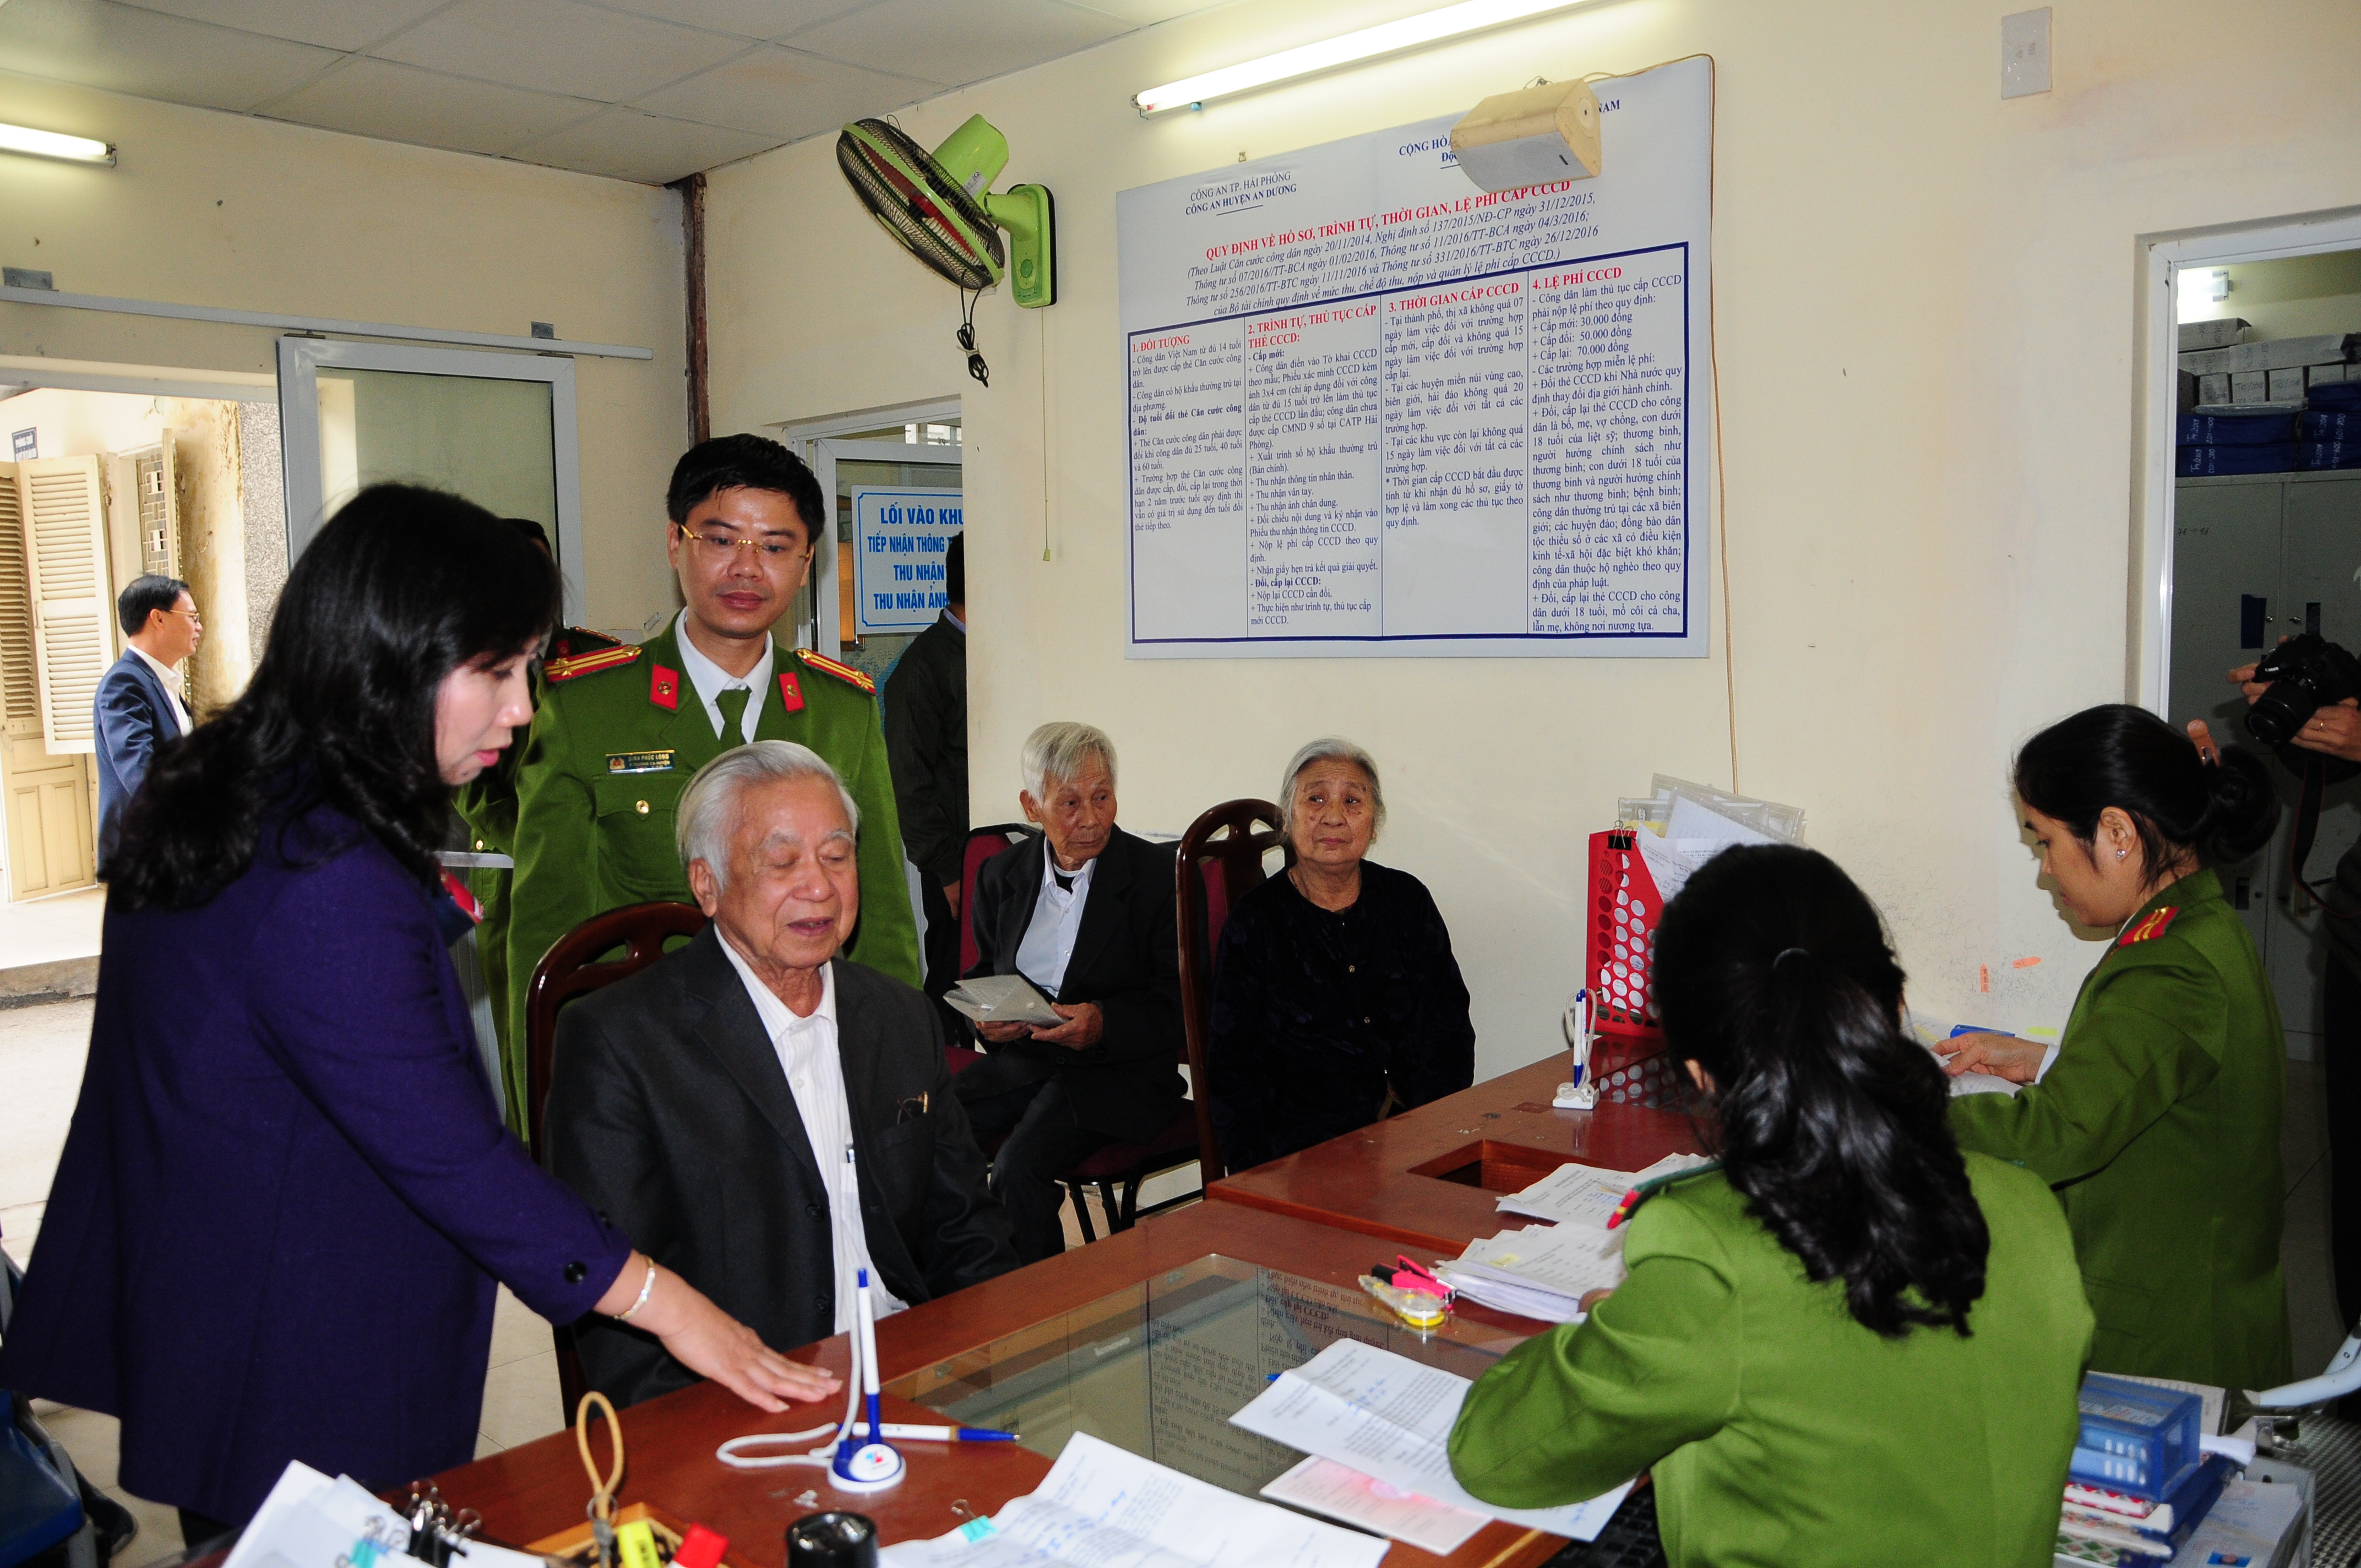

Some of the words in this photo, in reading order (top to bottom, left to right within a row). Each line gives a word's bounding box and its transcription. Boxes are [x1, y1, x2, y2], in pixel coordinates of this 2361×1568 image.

[1399, 141, 1429, 156] CỘNG
[1432, 134, 1451, 150] HÒ
[1185, 202, 1208, 215] CÔNG
[1209, 199, 1221, 210] AN
[1222, 192, 1250, 207] HUYỆN
[1252, 189, 1264, 201] AN
[1265, 183, 1297, 198] DƯƠNG
[1189, 187, 1214, 202] CÔNG
[1215, 184, 1227, 196] AN
[1228, 182, 1242, 193] TP.
[1243, 177, 1259, 190] HẢI
[1260, 171, 1291, 186] PHÒNG
[1205, 244, 1228, 262] QUY
[1231, 238, 1259, 256] ĐỊNH
[1260, 232, 1276, 248] VỀ
[1278, 229, 1297, 246] HỒ
[1297, 227, 1316, 242] SƠ,
[1317, 219, 1356, 238] TRÌNH
[1358, 214, 1379, 232] TỰ,
[1380, 206, 1413, 226] THỜI
[1415, 202, 1452, 219] GIAN,
[1454, 196, 1472, 214] LỆ
[1531, 278, 1541, 290] 4.
[1543, 274, 1560, 290] LỆ
[1562, 271, 1584, 286] PHÍ
[1586, 266, 1622, 282] CCCD
[1388, 301, 1397, 313] 3.
[1399, 294, 1427, 311] THỜI
[1429, 291, 1458, 306] GIAN
[1460, 286, 1484, 301] CẤP
[1486, 282, 1519, 297] CCCD
[1247, 324, 1255, 334] 2.
[1256, 317, 1287, 333] TRÌNH
[1289, 314, 1307, 329] TỰ,
[1308, 312, 1330, 325] THỦ
[1331, 308, 1353, 323] TỤC
[1354, 302, 1377, 318] CẤP
[1132, 343, 1139, 353] 1.
[1140, 337, 1156, 352] ĐỐI
[1157, 334, 1190, 349] TƯỢNG
[1247, 333, 1267, 349] THẺ
[1269, 332, 1300, 346] CCCD:
[880, 502, 902, 524] LỐI
[907, 504, 934, 524] VÀO
[867, 530, 886, 552] TIẾP
[889, 533, 914, 556] NHẬN
[916, 533, 945, 553] THÔNG
[893, 564, 913, 581] THU
[916, 561, 944, 584] NHẬN
[873, 593, 893, 609] THU
[896, 589, 925, 612] NHẬN
[928, 585, 949, 608] ẢNH
